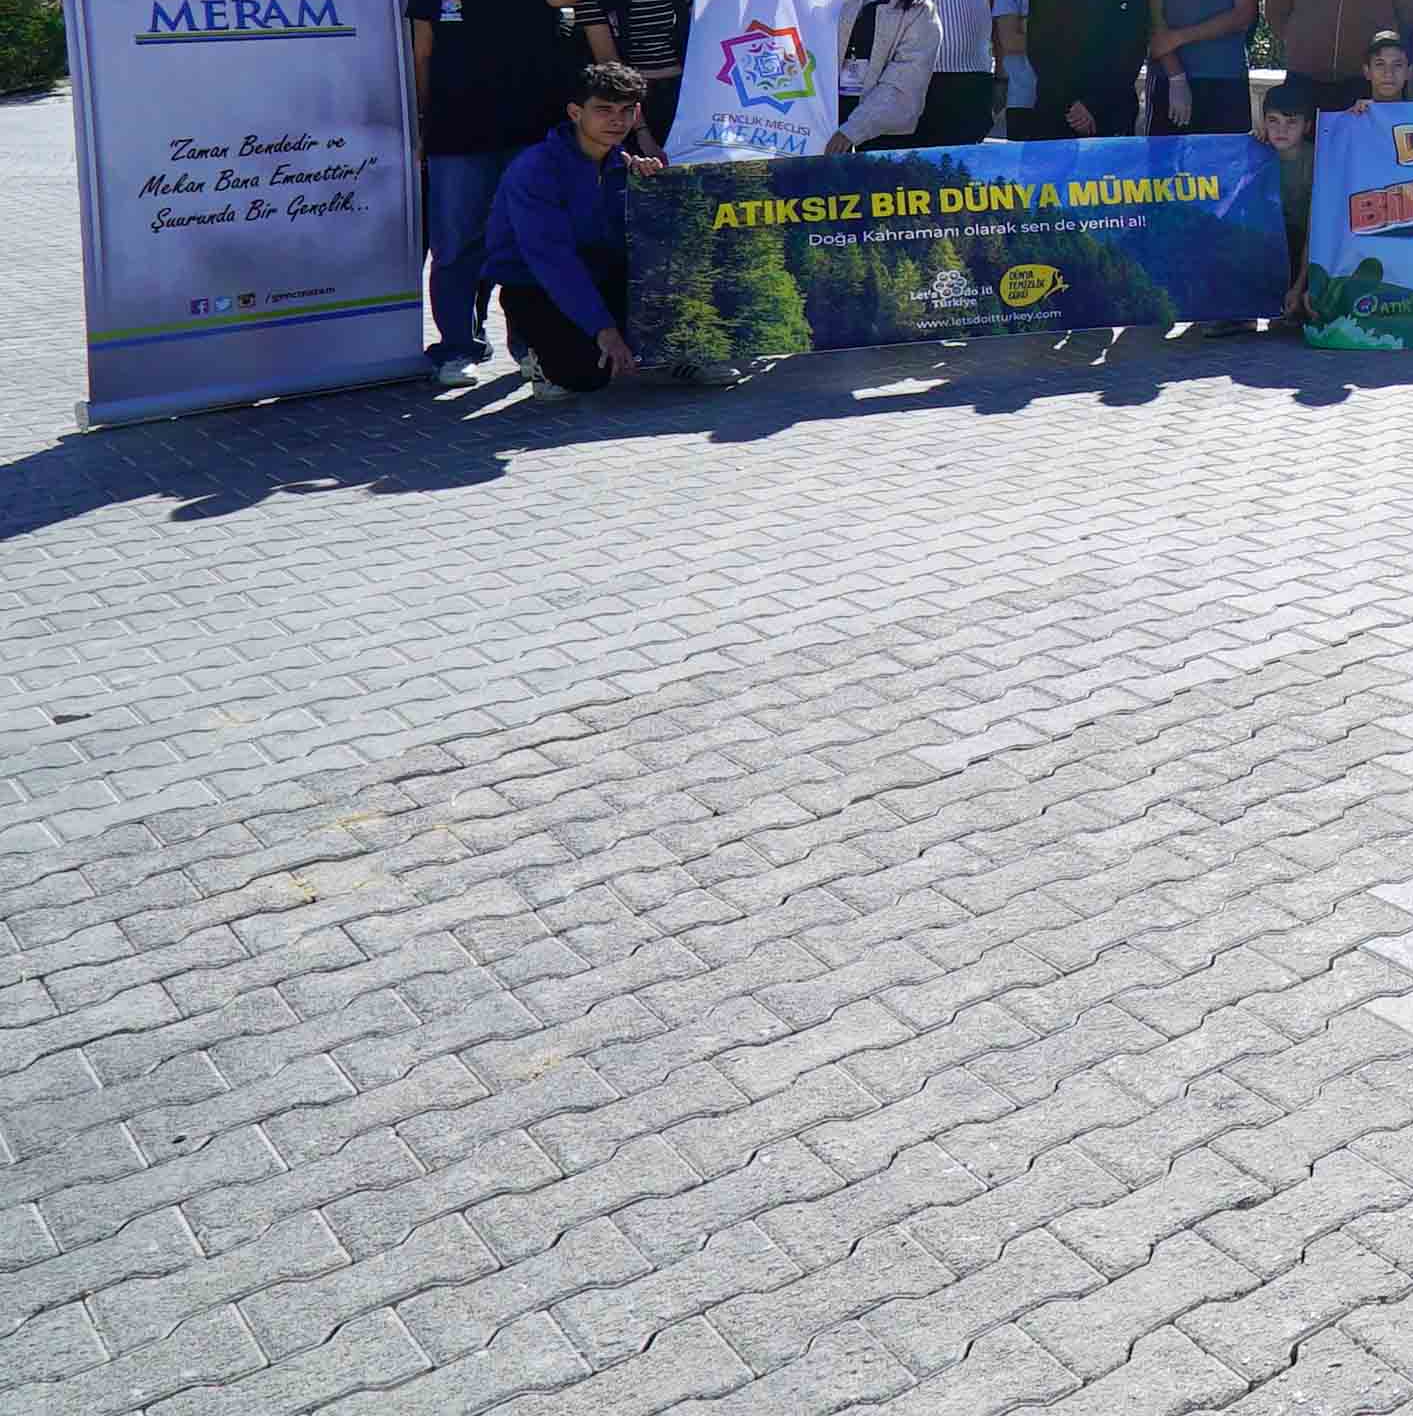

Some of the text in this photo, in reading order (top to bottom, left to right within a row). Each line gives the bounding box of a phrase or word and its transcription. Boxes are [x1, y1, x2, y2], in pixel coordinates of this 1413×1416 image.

[238, 133, 319, 157] Bendedir
[327, 136, 345, 149] ve
[138, 172, 205, 198] Mekan
[214, 169, 260, 192] Bana
[151, 204, 236, 234] Şuurunda
[246, 199, 278, 221] Bir
[712, 172, 1220, 230] ATIKSIZ BİR DÜNYA MÜMKÜN
[809, 215, 1147, 248] Doğa Kahramanı olarak sen de yerini al!
[916, 311, 1062, 330] www.letsdoitturkey.com
